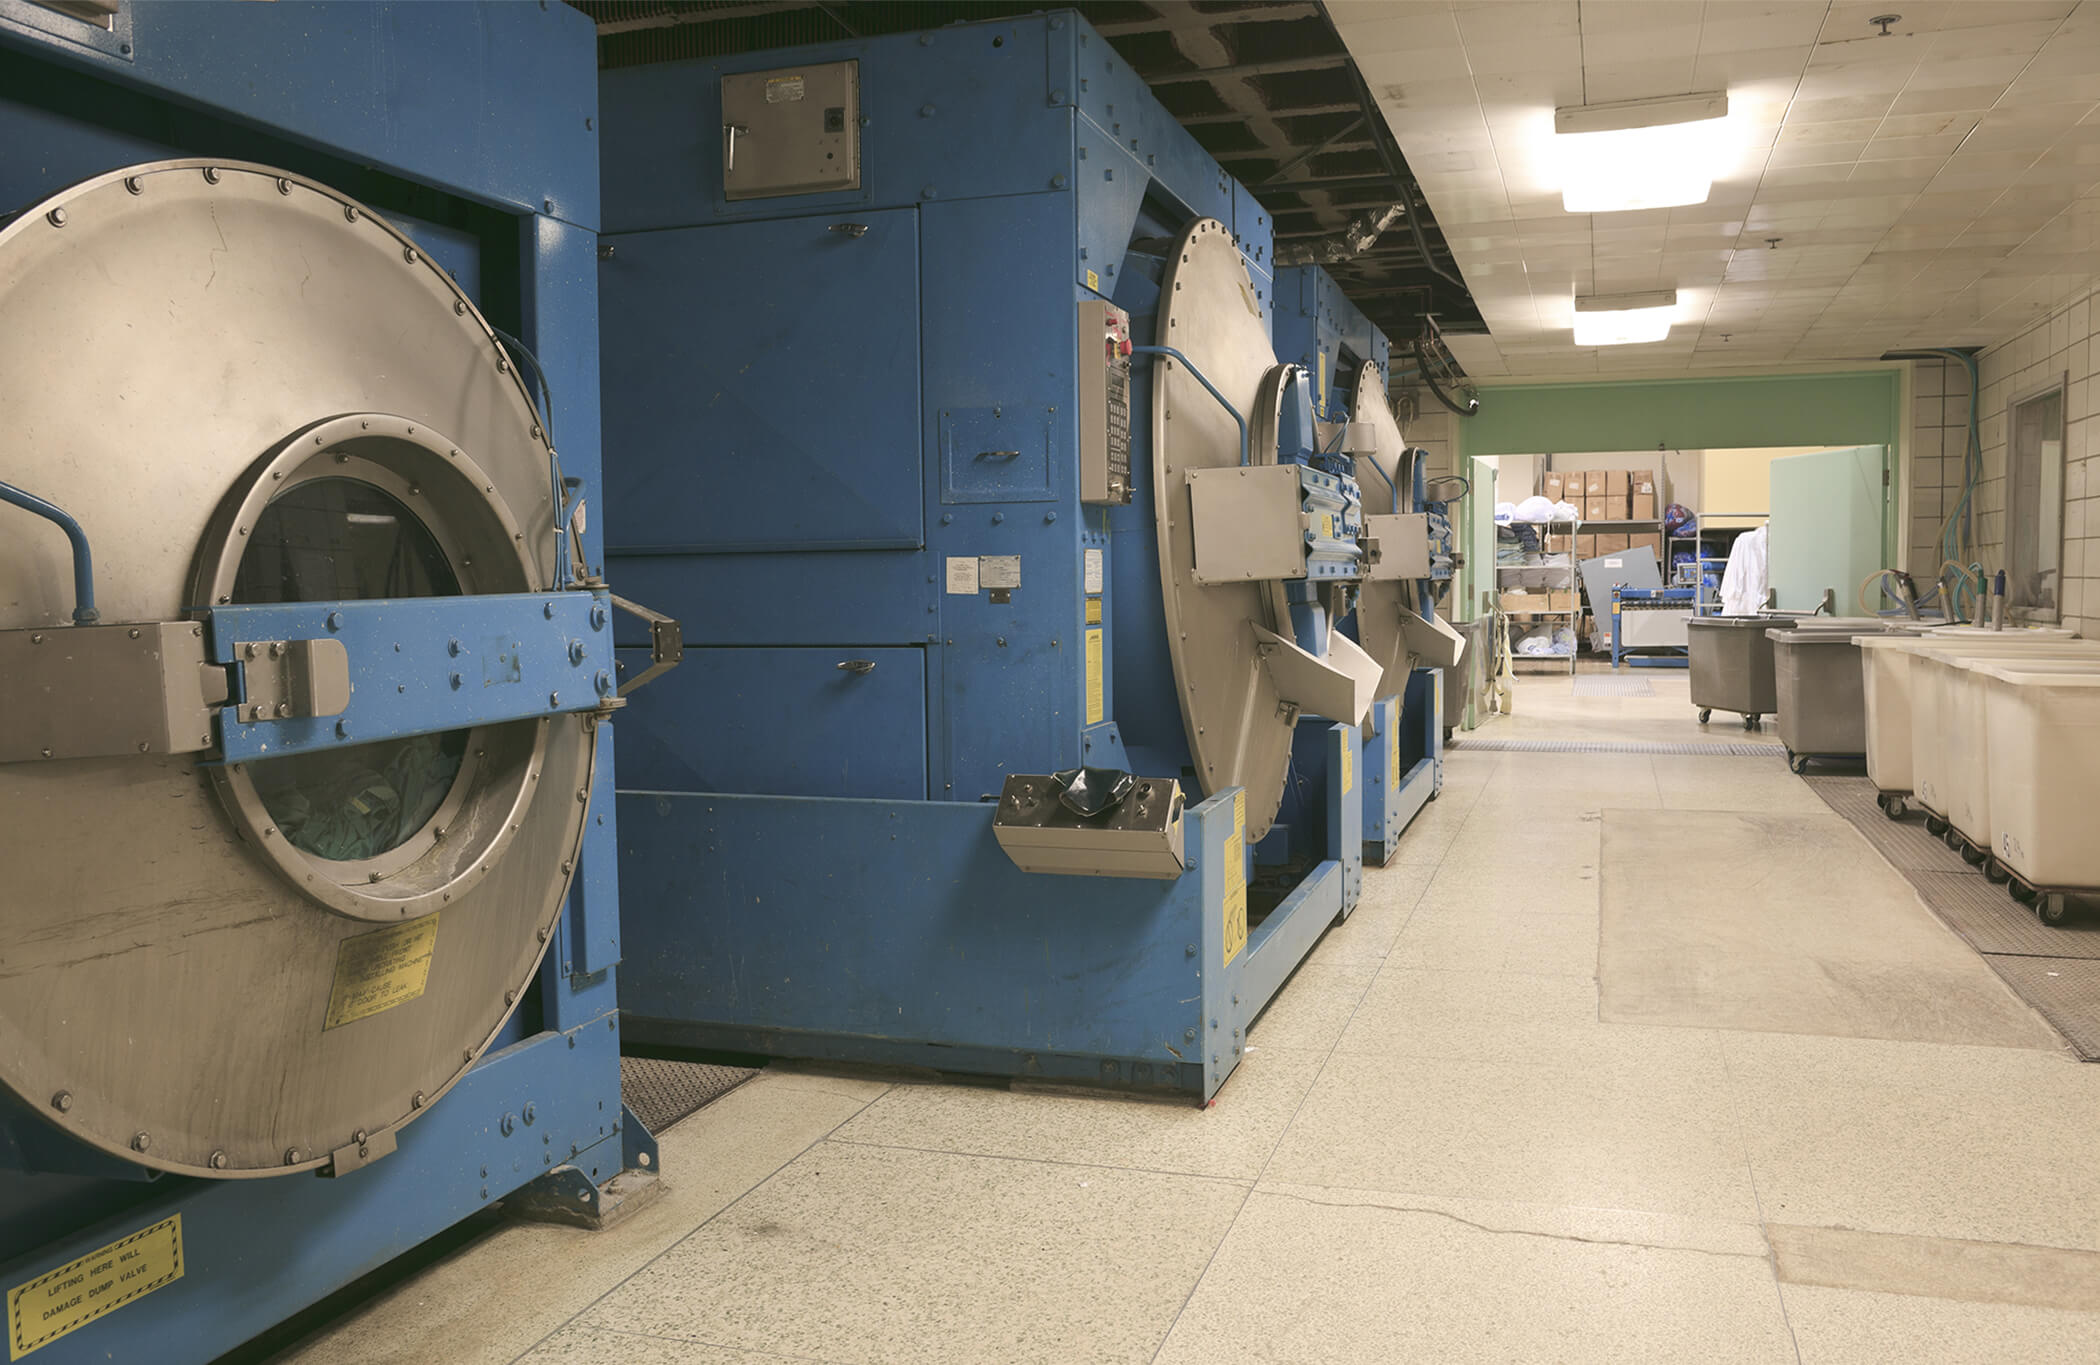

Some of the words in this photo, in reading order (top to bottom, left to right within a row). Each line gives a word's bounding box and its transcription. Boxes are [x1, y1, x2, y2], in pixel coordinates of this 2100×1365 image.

[42, 1296, 82, 1321] DAMAGE
[88, 1280, 114, 1298] DUMP
[119, 1264, 148, 1283] VALVE
[48, 1274, 84, 1297] LIFTING
[90, 1260, 113, 1277] HERE
[119, 1249, 141, 1263] WILL
